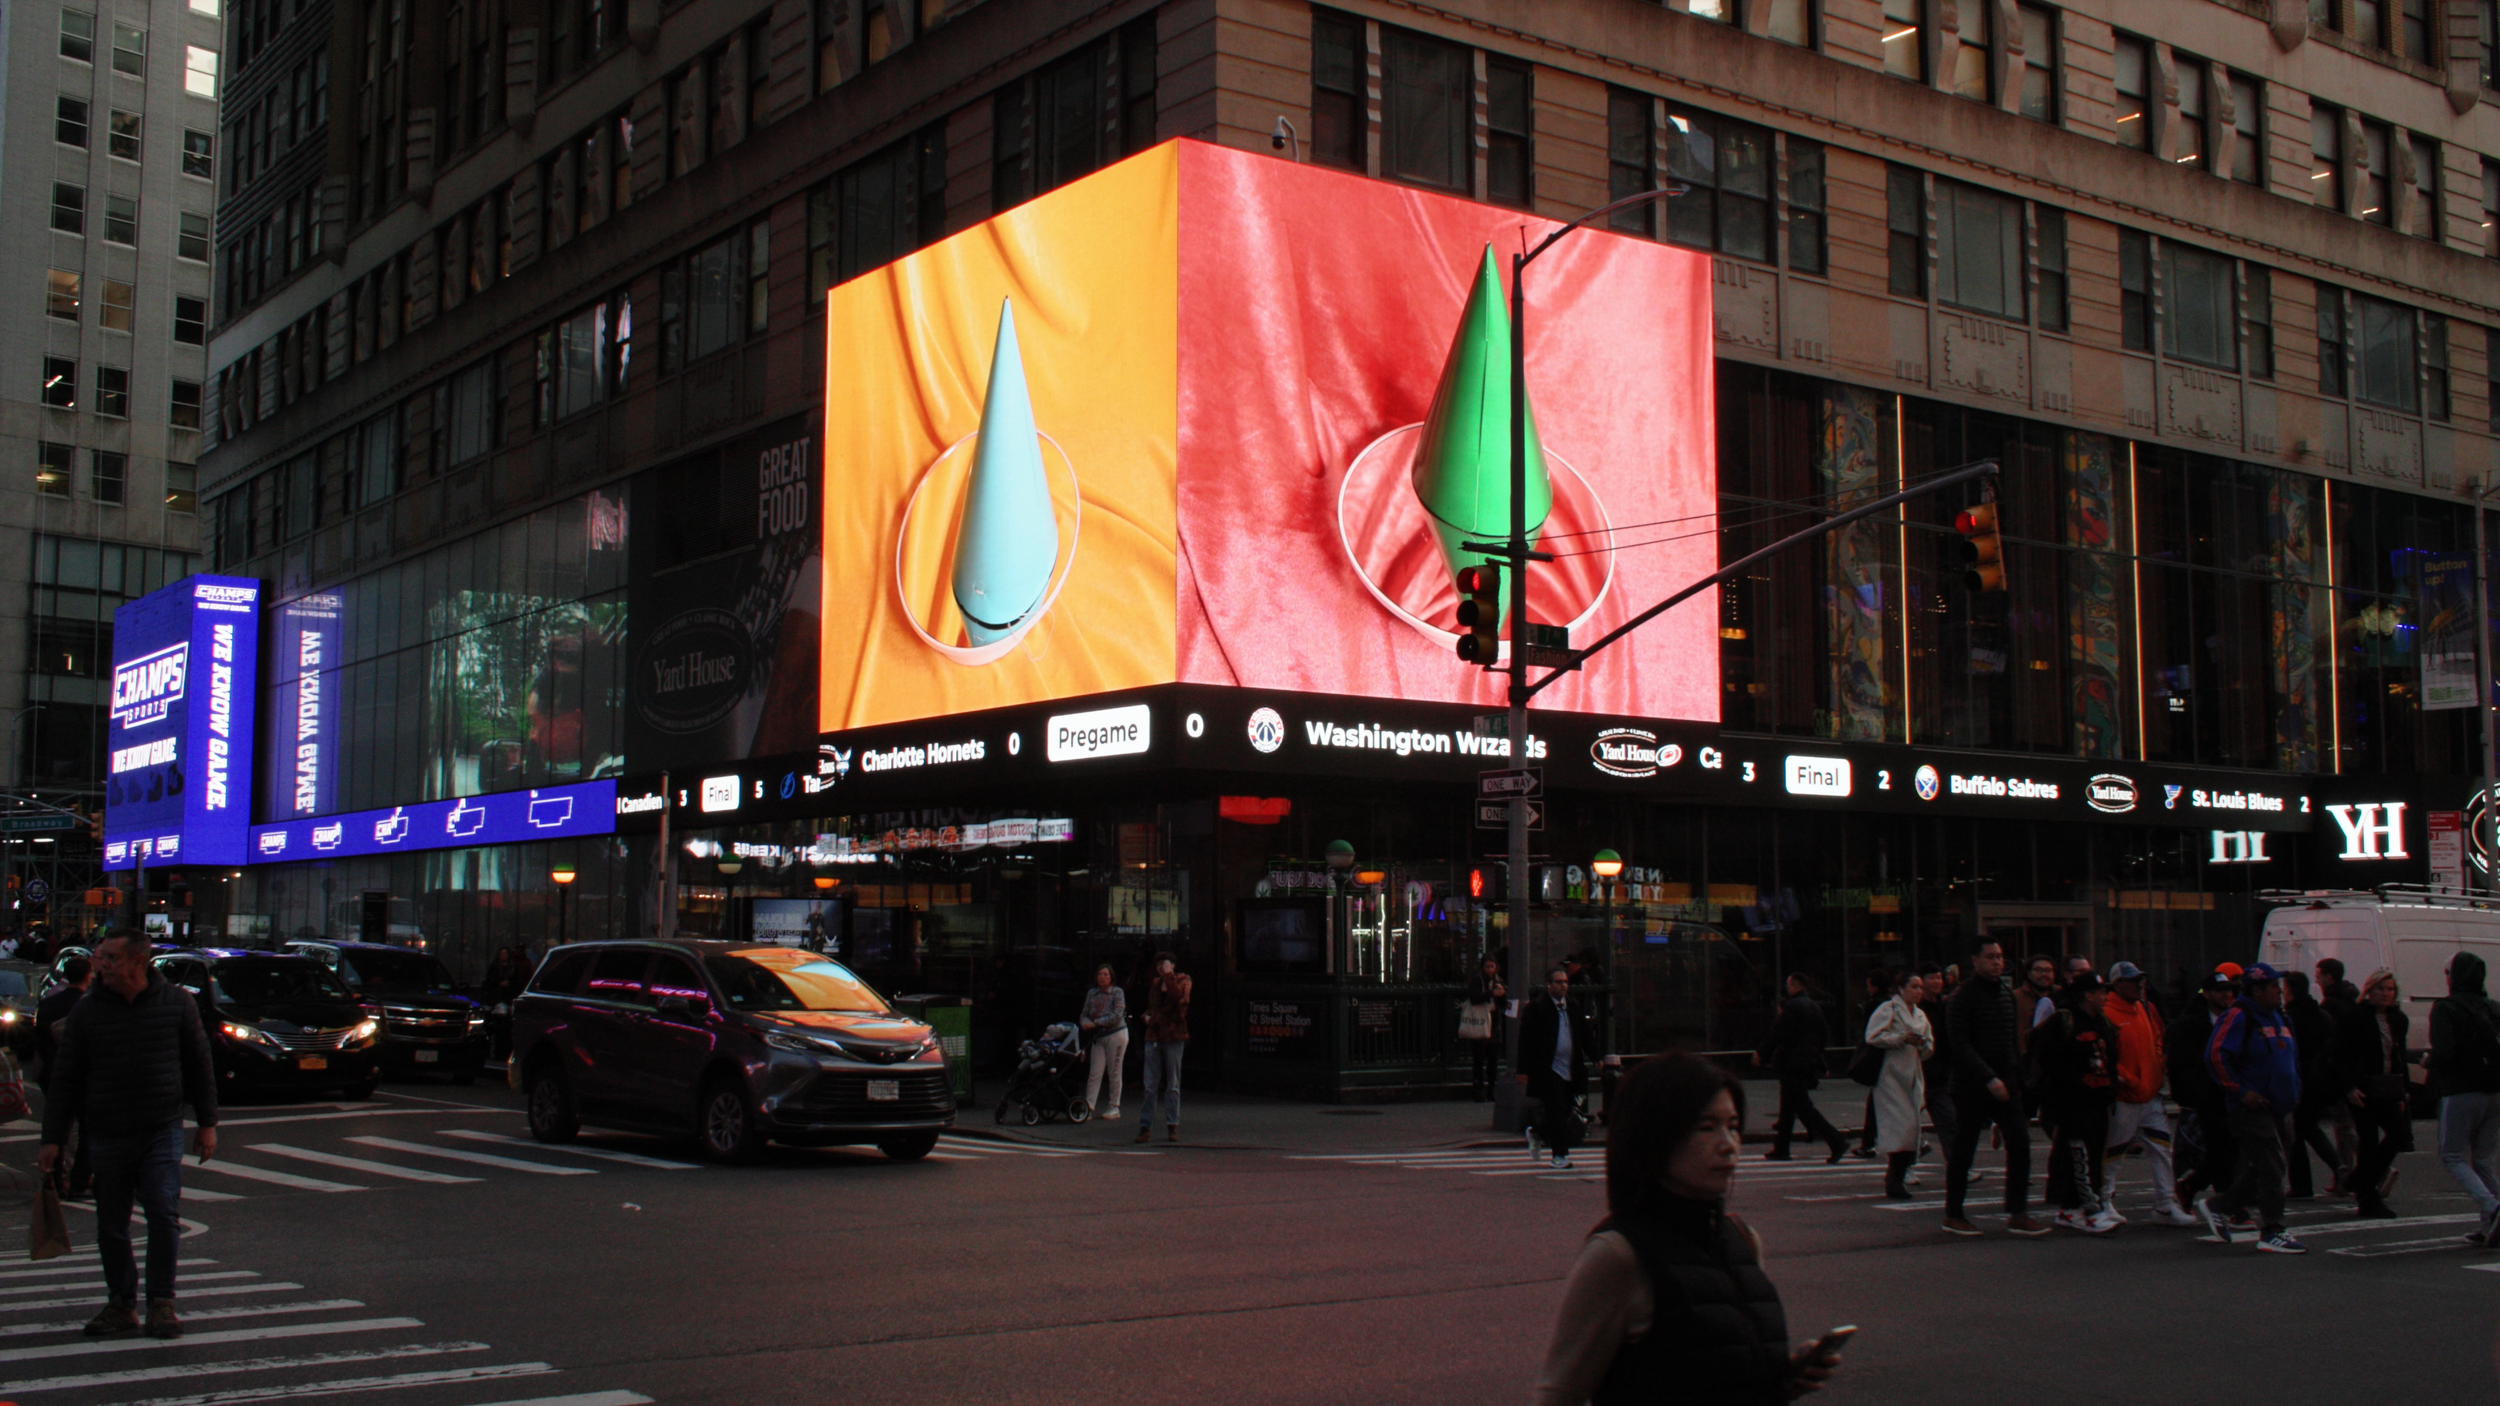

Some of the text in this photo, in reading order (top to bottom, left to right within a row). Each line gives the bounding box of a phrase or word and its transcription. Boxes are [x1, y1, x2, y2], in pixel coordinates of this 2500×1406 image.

[760, 437, 810, 492] GREAT
[758, 481, 808, 539] FOOD
[2425, 560, 2467, 573] Button
[2425, 573, 2445, 586] up!
[199, 587, 254, 598] CHAMPS
[213, 624, 233, 662] WE
[1544, 628, 1550, 644] 7
[1530, 647, 1567, 666] Fashion
[115, 653, 185, 709] CHAMPS
[653, 651, 736, 694] Yard House
[209, 662, 232, 737] KNOW
[128, 700, 165, 722] SPORTS
[1186, 712, 1204, 738] 0
[1493, 718, 1502, 733] 41
[1008, 732, 1020, 756] 0
[1059, 723, 1138, 752] Pregame
[1305, 721, 1450, 756] Washington
[1456, 730, 1548, 758] Wizads
[861, 739, 985, 772] Charlotte Hornets
[1598, 743, 1626, 760] Yard
[1742, 762, 1756, 782] 3
[1798, 766, 1839, 786] Final
[1878, 770, 1890, 790] 2
[708, 784, 732, 802] Final
[754, 780, 764, 799] 5
[1487, 777, 1532, 791] ONE WAY
[1950, 774, 2058, 799] Buffalo Sabres
[2091, 786, 2134, 800] Yard House
[679, 790, 688, 807] 3
[2192, 790, 2284, 812] St. Louis Blues
[2300, 796, 2311, 813] 2
[1486, 808, 1504, 820] ONE
[12, 820, 63, 829] Broadway
[2325, 802, 2410, 861] YH
[2430, 832, 2437, 840] 3
[2432, 874, 2440, 882] 6
[1249, 1002, 1298, 1014] Times Square
[1249, 1014, 1312, 1026] 42 Street Station
